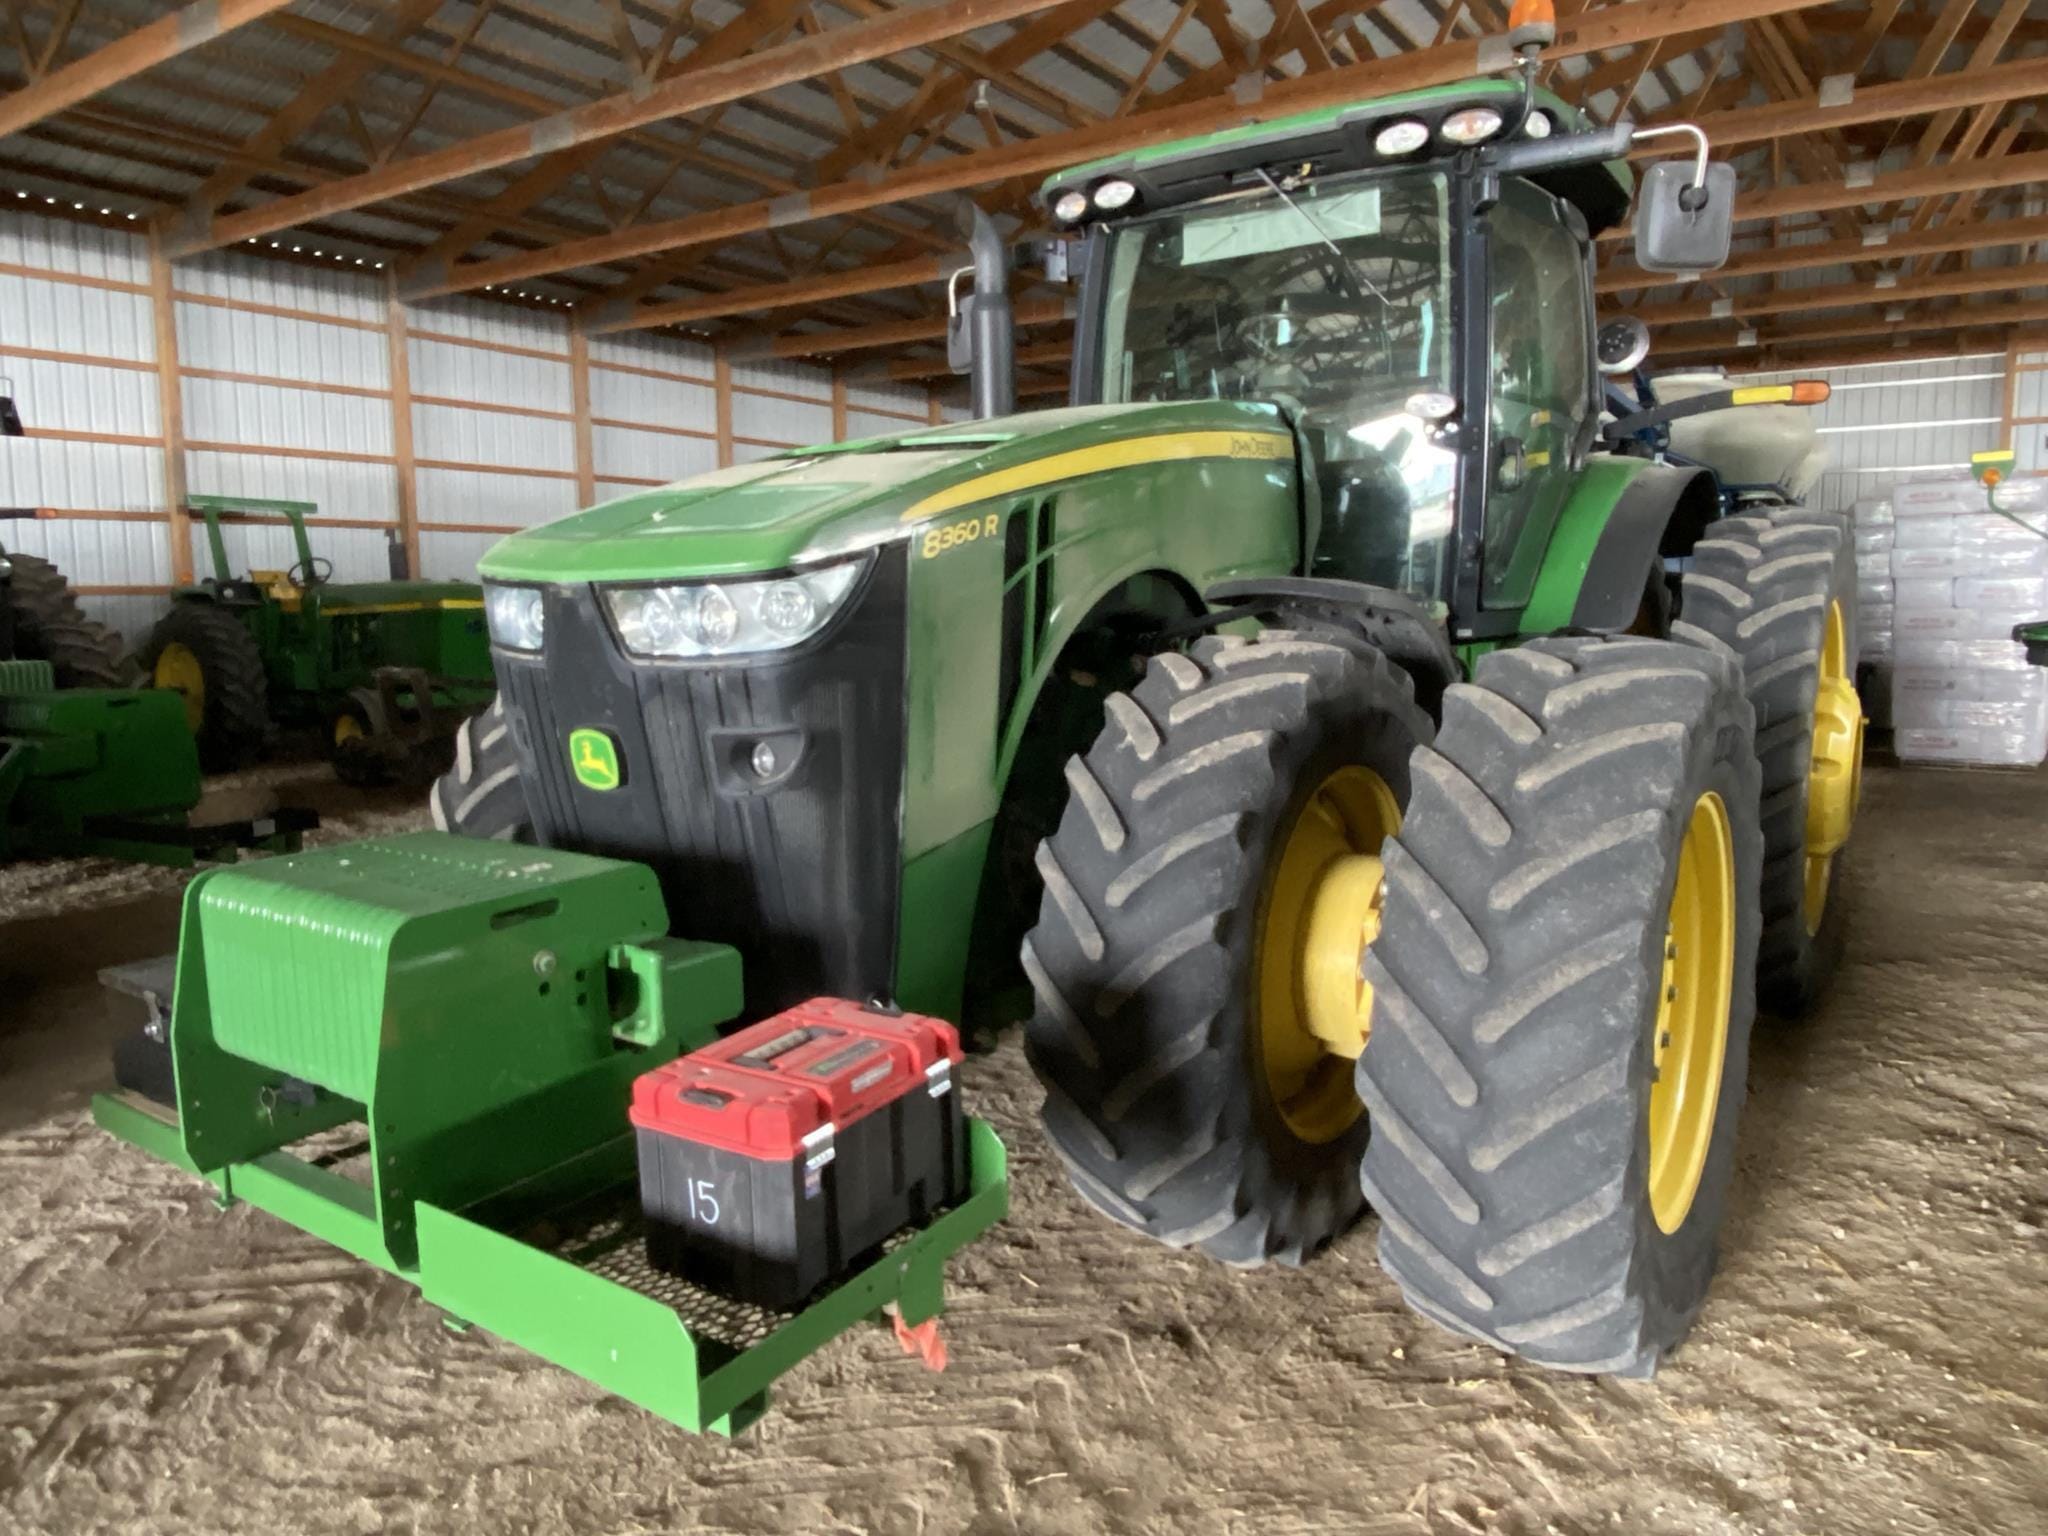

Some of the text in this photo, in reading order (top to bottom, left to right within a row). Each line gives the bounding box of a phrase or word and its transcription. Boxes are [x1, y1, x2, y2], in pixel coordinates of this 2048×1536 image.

[923, 514, 999, 559] 8360 R
[688, 1178, 720, 1225] 15
